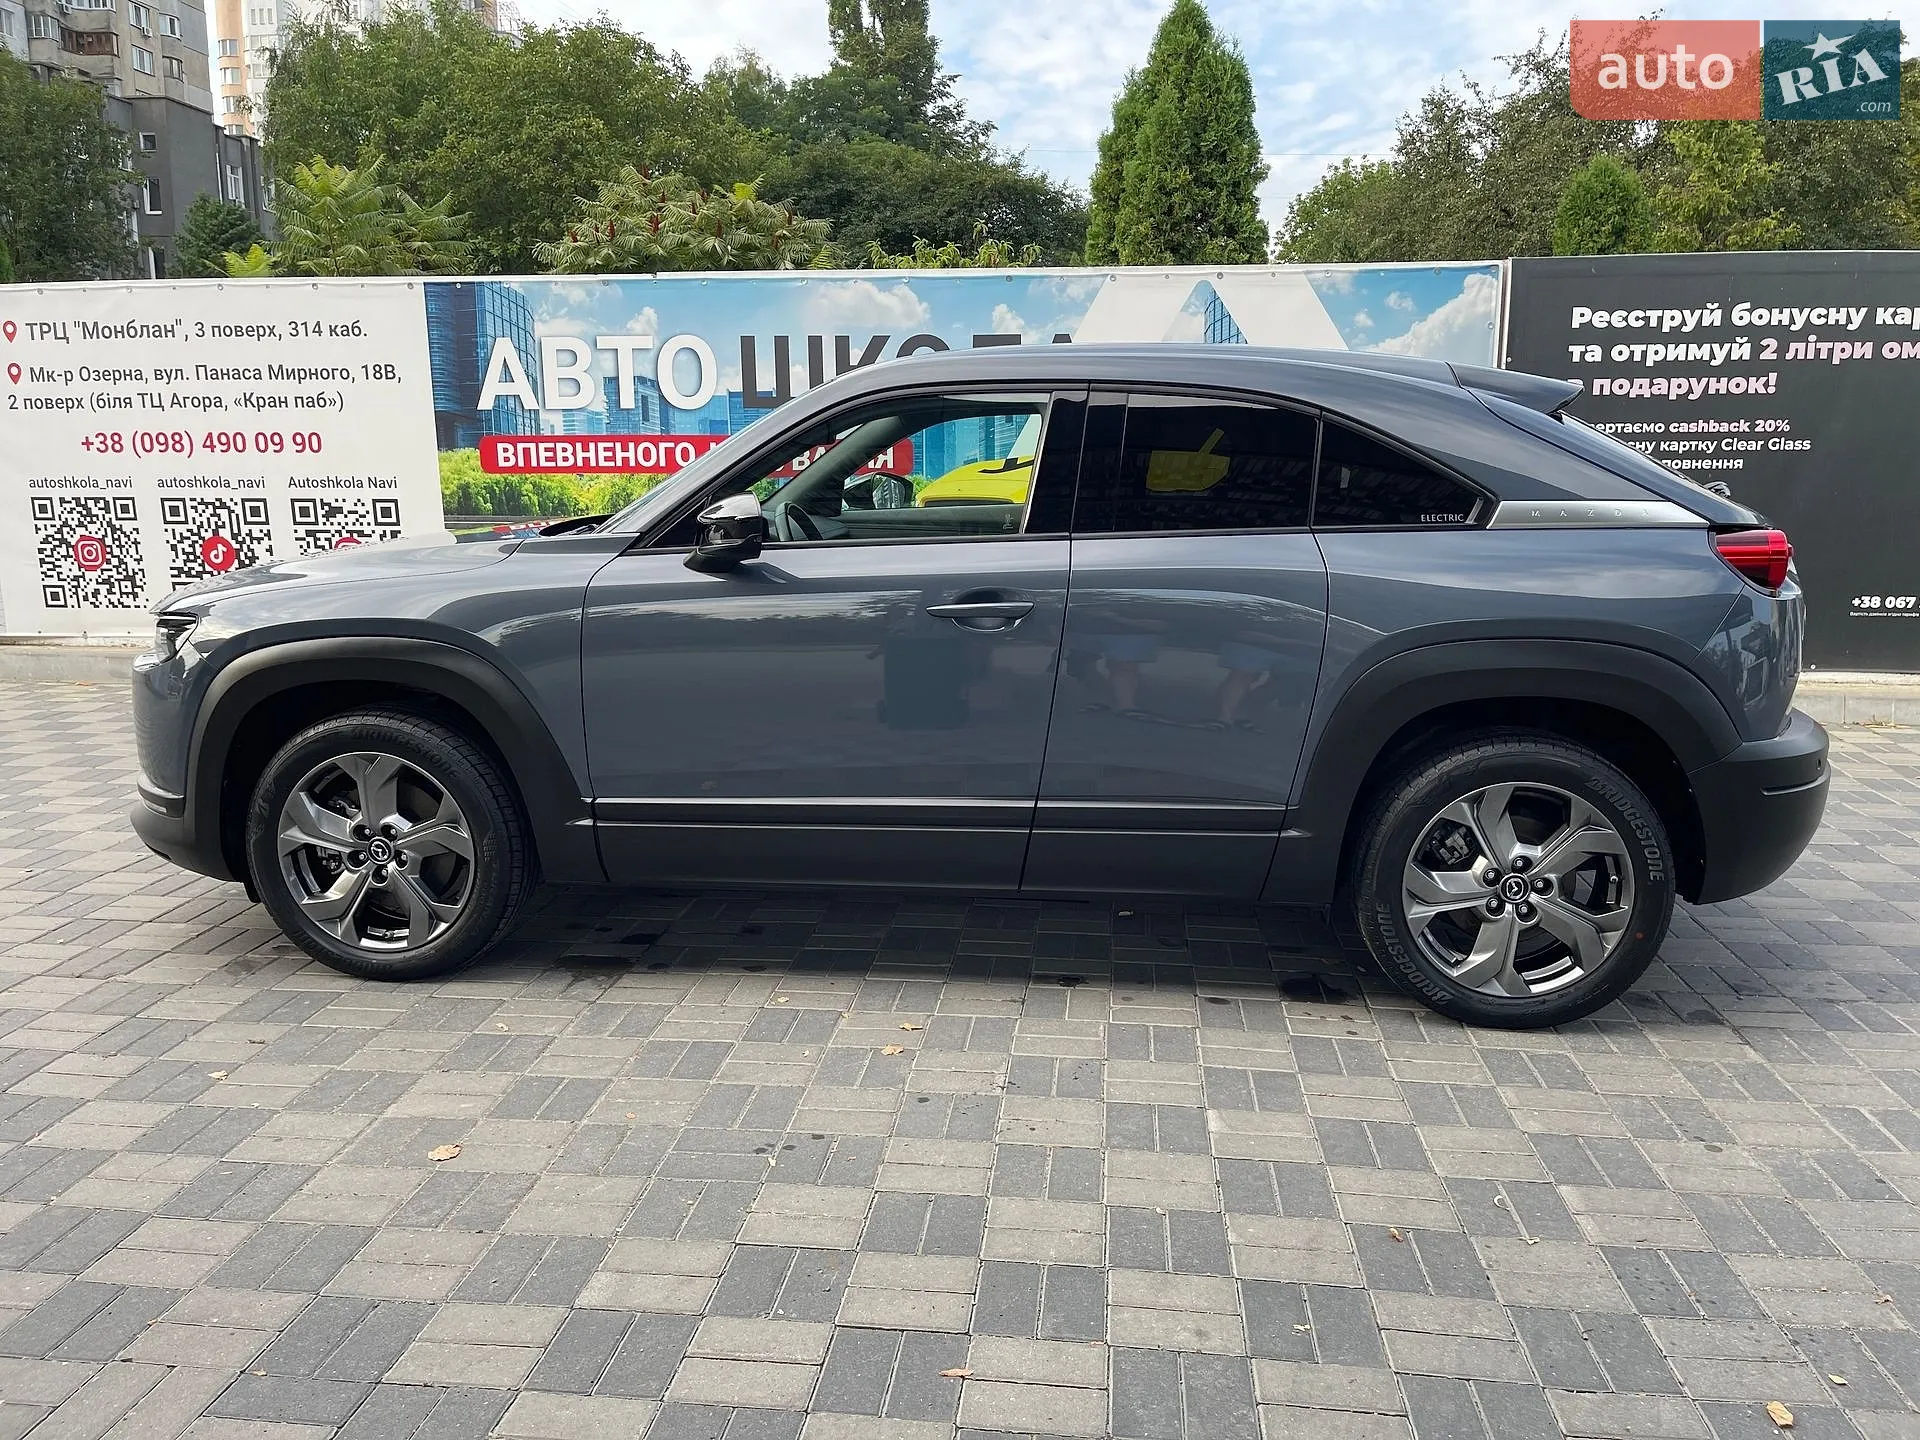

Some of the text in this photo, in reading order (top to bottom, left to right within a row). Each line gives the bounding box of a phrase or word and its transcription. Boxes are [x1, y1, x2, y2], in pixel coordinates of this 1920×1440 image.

[1571, 302, 1722, 332] Реєструй
[1731, 301, 1868, 331] бонусну
[25, 319, 368, 344] ТРЦ "Монблан", 3 поверх, 314 каб.
[1568, 344, 1602, 362] та
[1610, 336, 1751, 366] отримуй
[1759, 338, 1778, 360] 2
[1785, 334, 1873, 365] літри
[30, 363, 401, 386] Мк-р Озерна, вул. Панаса Мирного, 18В,
[476, 334, 719, 411] АВТО
[1592, 372, 1778, 400] подарунок!
[8, 391, 344, 413] 2 поверх (біля ТЦ Агора, «Кран паб»)
[1669, 419, 1750, 433] cashback
[1755, 419, 1790, 432] 20%
[81, 430, 323, 459] +38 (098) 490 09 90
[496, 440, 697, 469] ВПЕВНЕНОГО
[1660, 440, 1717, 454] картку
[1721, 438, 1764, 450] Clear
[1768, 437, 1811, 450] Glass
[28, 476, 133, 490] autoshkola_navi
[157, 476, 266, 490] autoshkola_navi
[288, 476, 398, 490] Autoshkola Navi
[1421, 513, 1464, 522] ELECTRIC
[1851, 595, 1917, 609] +38 067
[1584, 777, 1665, 883] BRIDGESTONE
[1375, 901, 1454, 1006] BRIDGESTONE
